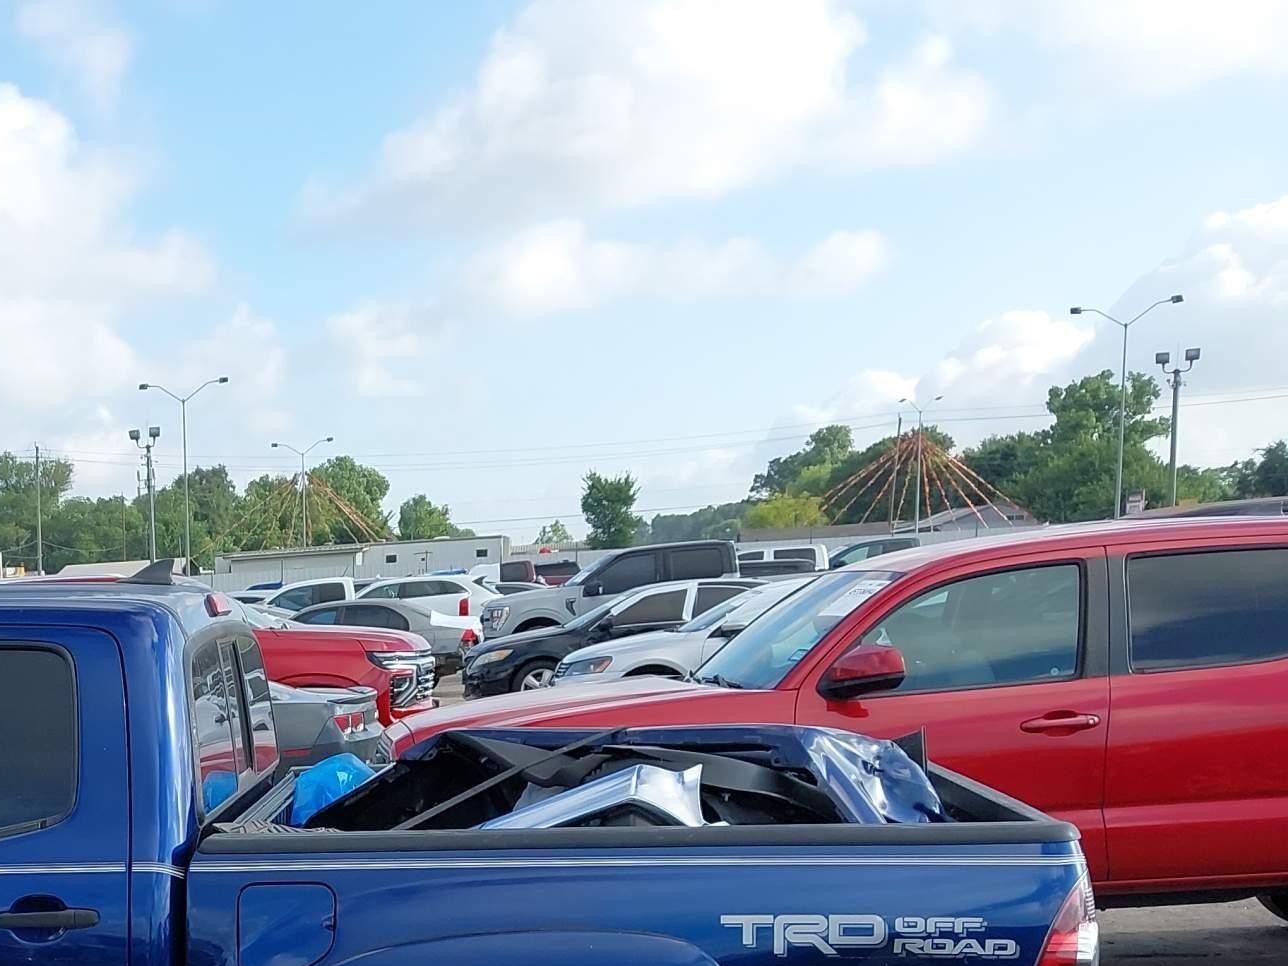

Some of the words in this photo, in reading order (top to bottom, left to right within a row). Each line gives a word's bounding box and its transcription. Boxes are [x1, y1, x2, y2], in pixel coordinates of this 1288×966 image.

[720, 914, 888, 958] TRD
[894, 916, 988, 937] OFF
[893, 938, 1021, 959] ROAD
